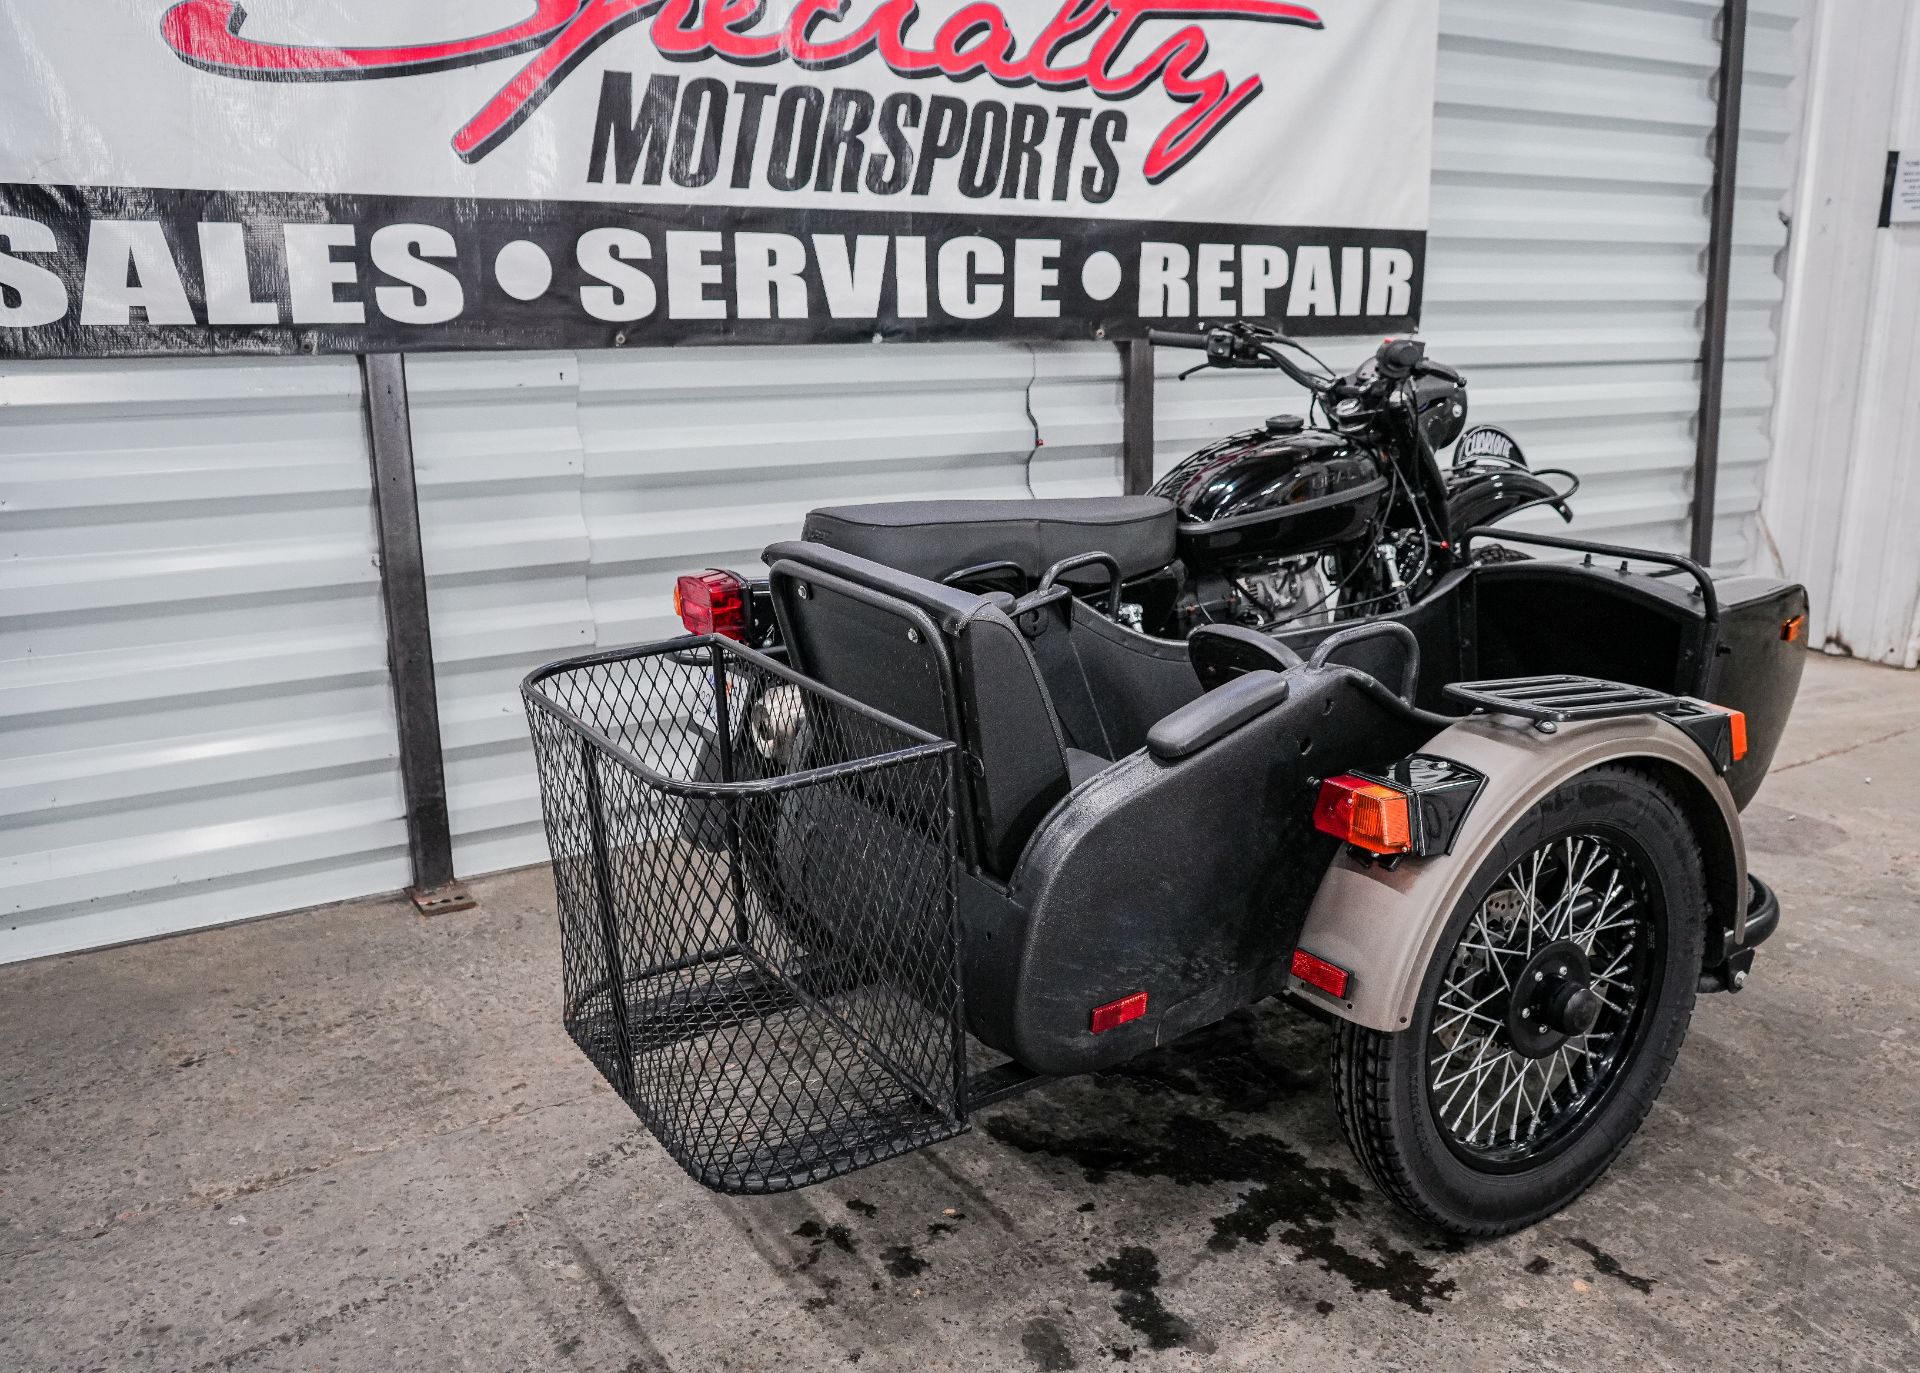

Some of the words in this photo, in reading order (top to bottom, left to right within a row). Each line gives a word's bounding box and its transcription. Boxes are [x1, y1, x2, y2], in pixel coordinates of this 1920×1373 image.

[586, 69, 1128, 205] MOTORSPORTS
[0, 214, 464, 328] SALES
[576, 226, 1062, 323] SERVICE
[1138, 240, 1414, 319] REPAIR
